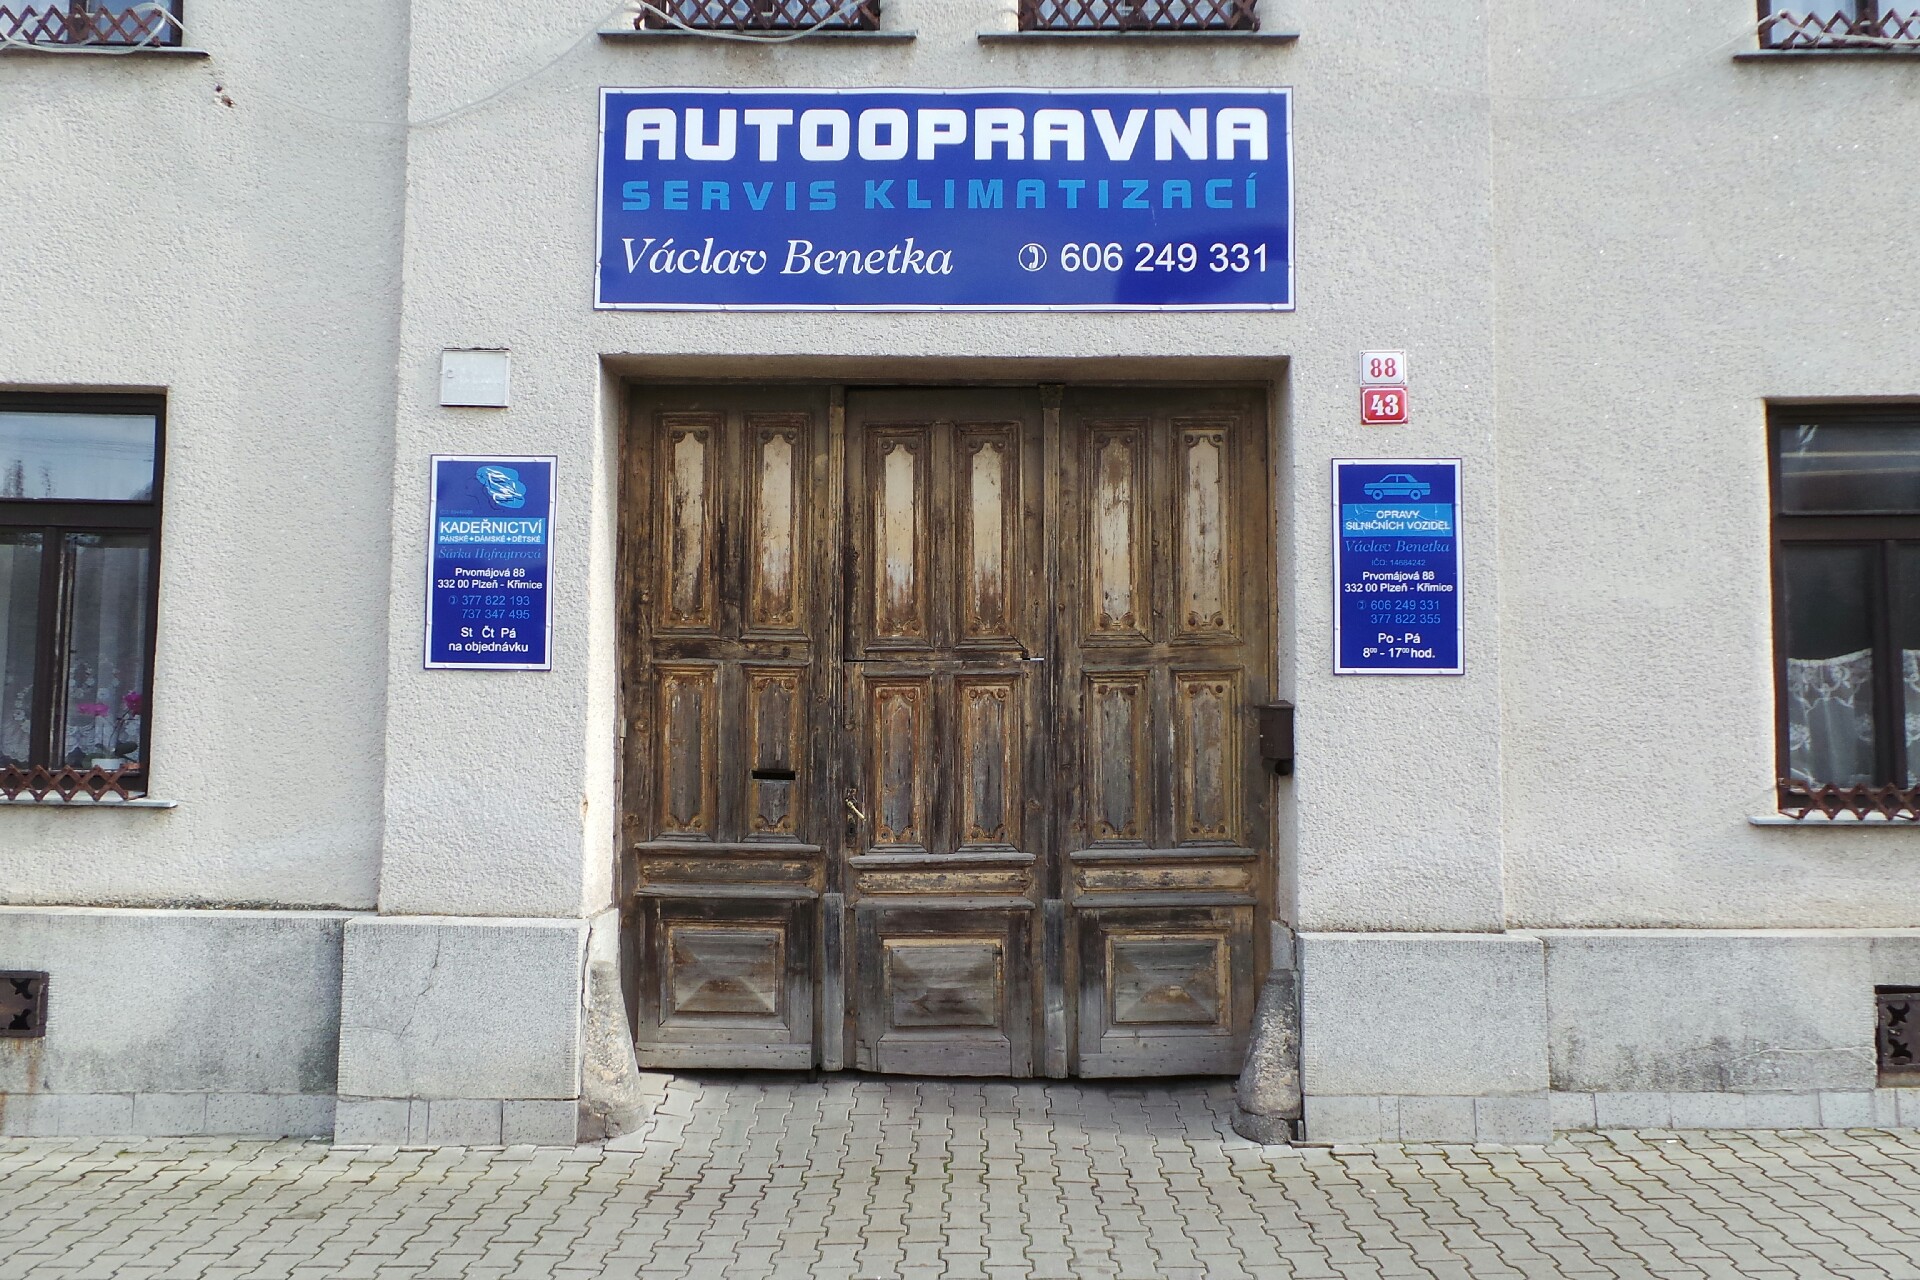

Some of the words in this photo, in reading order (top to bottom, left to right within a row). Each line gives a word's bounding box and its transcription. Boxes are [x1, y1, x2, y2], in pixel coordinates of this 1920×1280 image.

[624, 107, 1269, 162] AUTOOPRAVNA
[622, 180, 838, 212] SERVIS
[864, 172, 1258, 210] KLIMATIZACÍ
[622, 236, 767, 276] Václav
[781, 239, 953, 276] Benetka
[1060, 242, 1123, 273] 606
[1135, 242, 1198, 273] 249
[1209, 242, 1268, 273] 331
[1370, 357, 1396, 378] 88
[1371, 394, 1399, 416] 43
[1376, 510, 1420, 519] OPRAVY
[440, 518, 542, 534] KADEŘNICTVÍ
[1345, 520, 1404, 530] SILNIČNÍCH
[1406, 521, 1450, 530] VOZIDEL
[440, 534, 468, 543] PÁNSKÉ
[474, 534, 506, 543] DÁMSKÉ
[1345, 540, 1391, 552] Václav
[1395, 540, 1450, 552] Benetka
[455, 567, 511, 579] Prvomájová
[512, 568, 526, 578] 88
[1362, 571, 1420, 582] Prvomájová
[1422, 571, 1435, 581] 88
[437, 579, 456, 589] 332
[457, 579, 470, 589] 00
[471, 579, 498, 589] Plzeň
[507, 579, 543, 589] Křimice
[1344, 583, 1363, 592] 332
[1365, 583, 1378, 592] 00
[1380, 583, 1408, 592] Plzeň
[1416, 583, 1453, 592] Křimice
[461, 595, 482, 606] 377
[485, 595, 506, 606] 822
[509, 595, 530, 606] 193
[1370, 600, 1392, 610] 606
[1395, 600, 1416, 610] 249
[1419, 600, 1440, 610] 331
[462, 609, 482, 619] 737
[484, 609, 505, 619] 347
[508, 609, 530, 619] 495
[1370, 614, 1391, 624] 377
[1395, 614, 1416, 624] 822
[1419, 614, 1441, 624] 355
[460, 626, 473, 638] St
[481, 625, 495, 638] Čt
[500, 627, 517, 638] Pá
[1378, 633, 1394, 644] Po
[1404, 632, 1421, 644] Pá
[448, 643, 462, 651] na
[464, 641, 529, 654] objednávku
[1410, 647, 1436, 658] hod.
